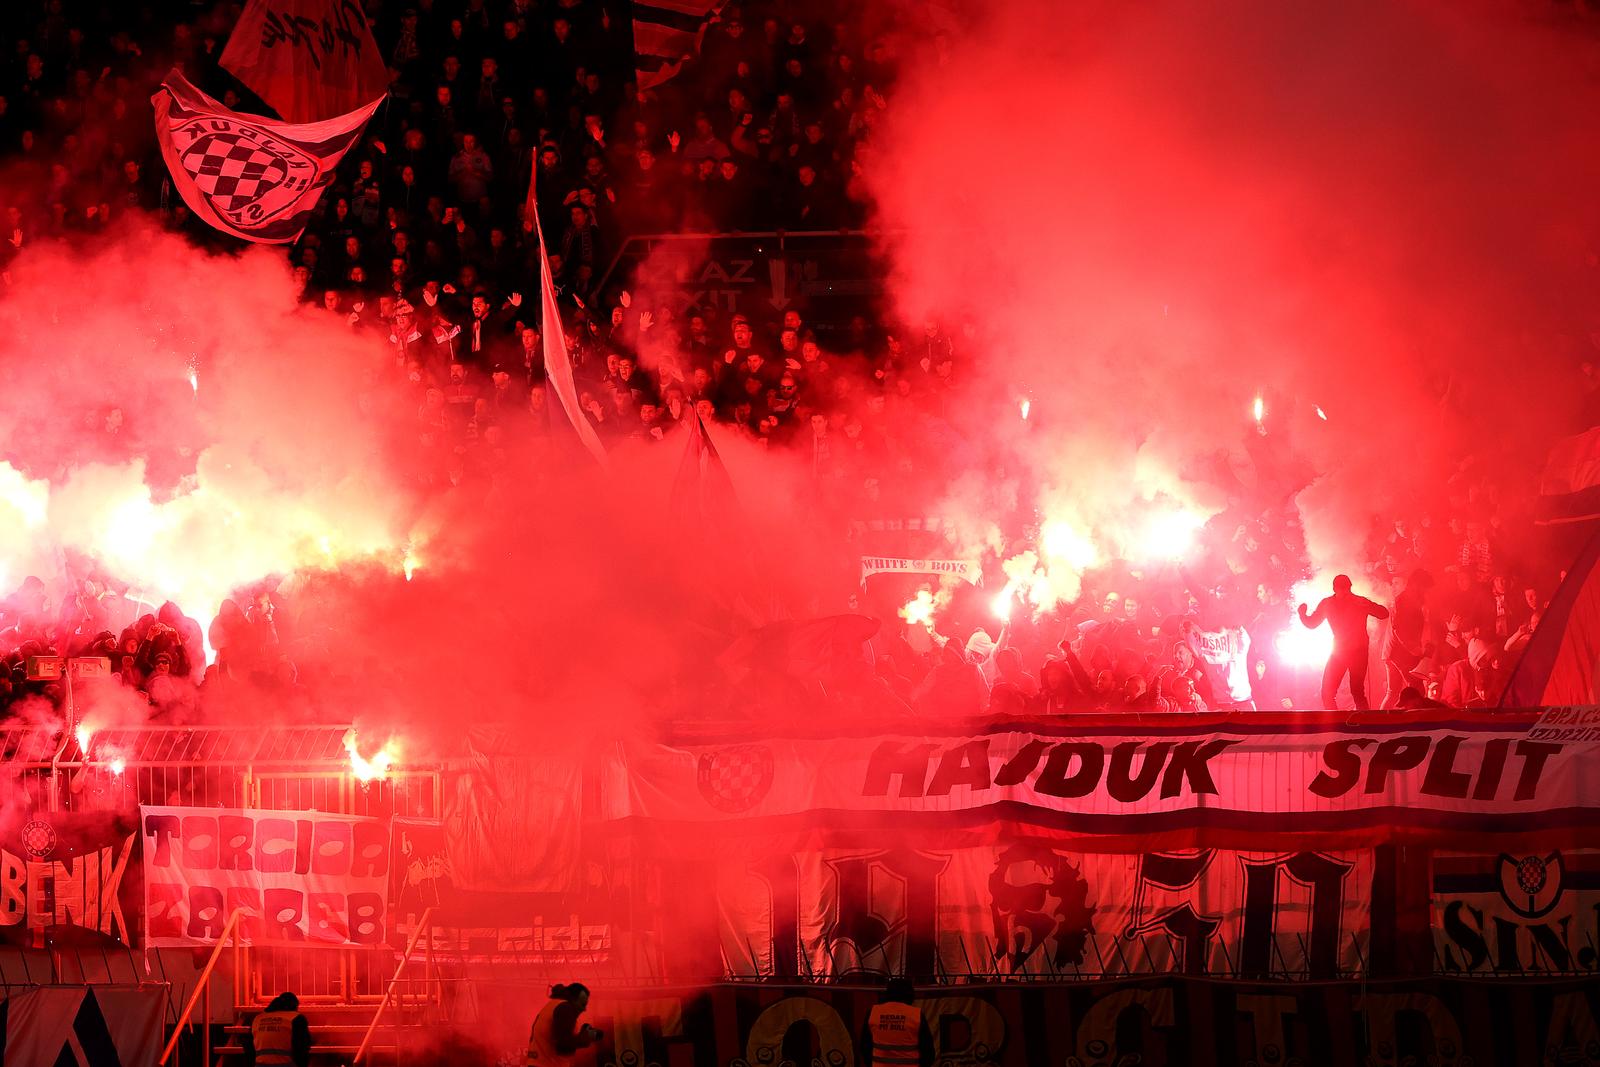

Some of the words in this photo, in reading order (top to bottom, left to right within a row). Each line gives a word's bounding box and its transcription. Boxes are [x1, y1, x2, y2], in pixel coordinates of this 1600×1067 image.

[862, 558, 908, 570] WHITE
[931, 562, 968, 573] BOYS
[861, 738, 1245, 803] HAJDUK
[1308, 735, 1564, 801] SPLIT
[145, 815, 391, 878] TORCIDA
[0, 831, 137, 948] BENIK
